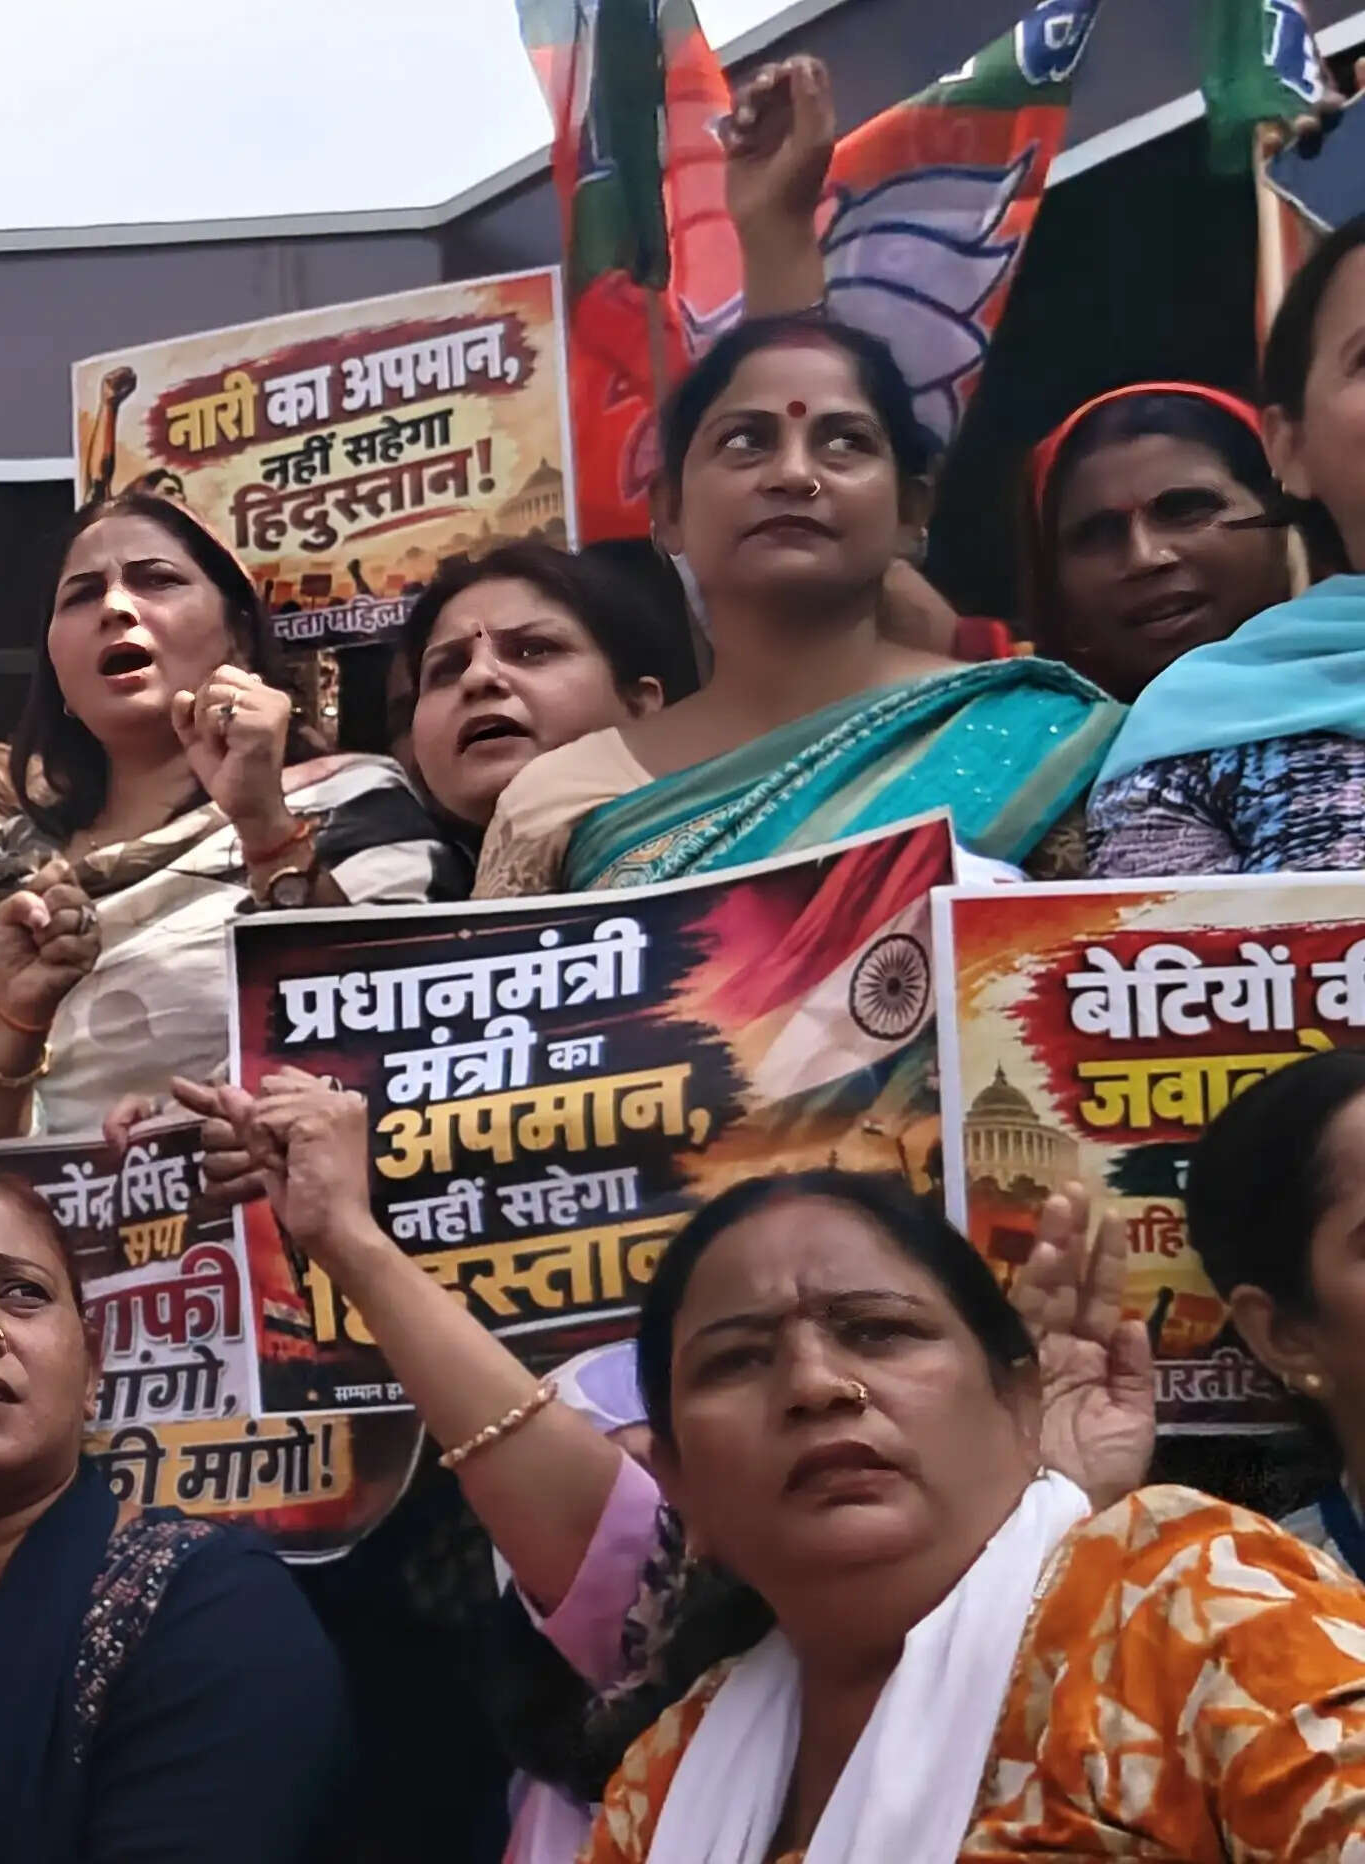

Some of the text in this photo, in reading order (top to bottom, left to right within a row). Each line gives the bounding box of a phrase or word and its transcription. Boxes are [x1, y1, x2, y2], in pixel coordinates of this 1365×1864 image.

[167, 322, 521, 453] नारी का अपमान,
[260, 408, 454, 486] नहीं सहेगा
[279, 917, 648, 1044] प्रधानमंत्री
[1066, 941, 1296, 1039] बेटियों
[384, 1014, 605, 1105] मंत्री का
[375, 1062, 712, 1180] अपमान,
[121, 1142, 190, 1218] सिंह
[389, 1164, 640, 1245] नहीं सहेगा
[119, 1214, 189, 1267] सपा
[177, 1416, 333, 1501] मांगो!
